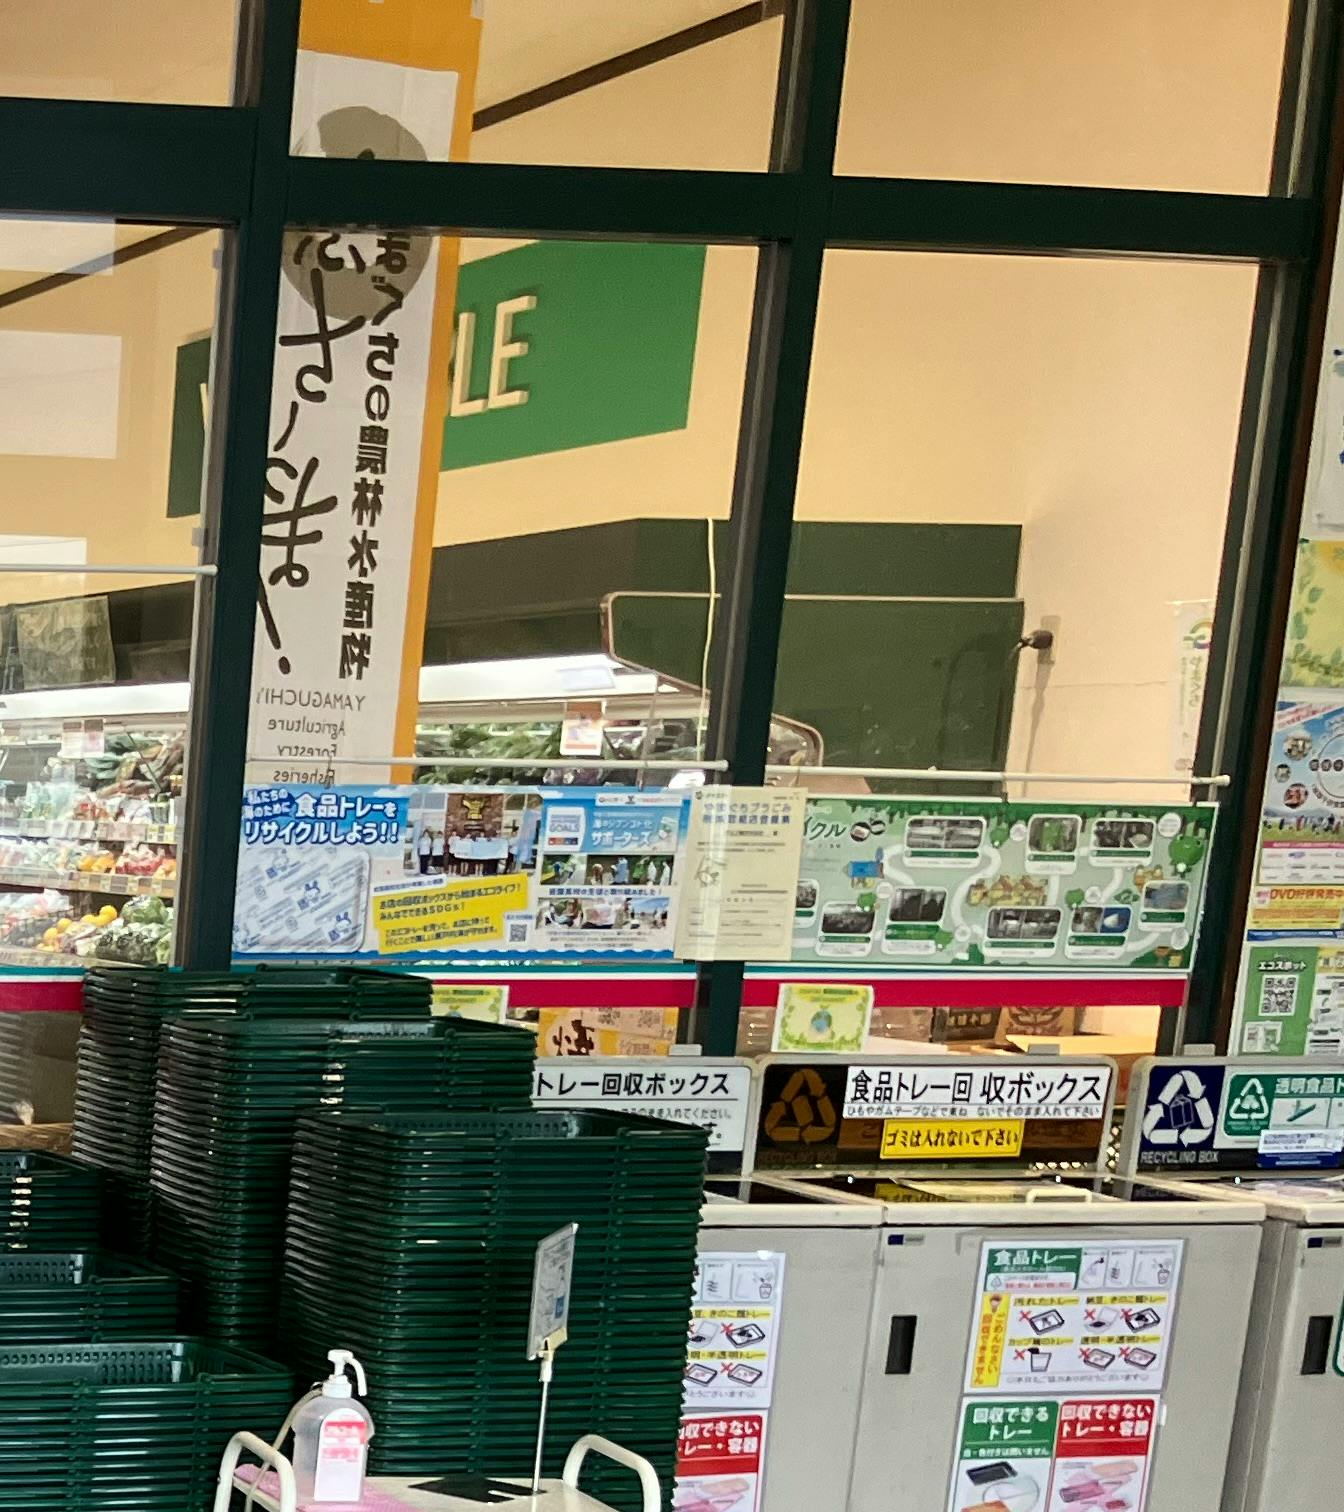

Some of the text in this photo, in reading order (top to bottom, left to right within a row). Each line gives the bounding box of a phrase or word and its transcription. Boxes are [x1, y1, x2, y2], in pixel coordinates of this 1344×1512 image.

[295, 792, 398, 819] 食品トレーを
[244, 820, 400, 845] リサイクルしよう!!
[1257, 960, 1307, 972] エコスポット
[536, 1070, 730, 1098] トレー回収ボックス
[850, 1069, 1102, 1105] 食品トレー回収ボックス
[885, 1127, 1020, 1148] ゴミは入れないで下さい
[1141, 1151, 1219, 1165] RECYCLING BOX
[993, 1249, 1078, 1267] 食品トレー
[972, 1406, 1049, 1424] 回収できる
[1060, 1403, 1152, 1421] 回収できない
[989, 1424, 1033, 1441] トレー
[677, 1436, 759, 1456] レー・容器
